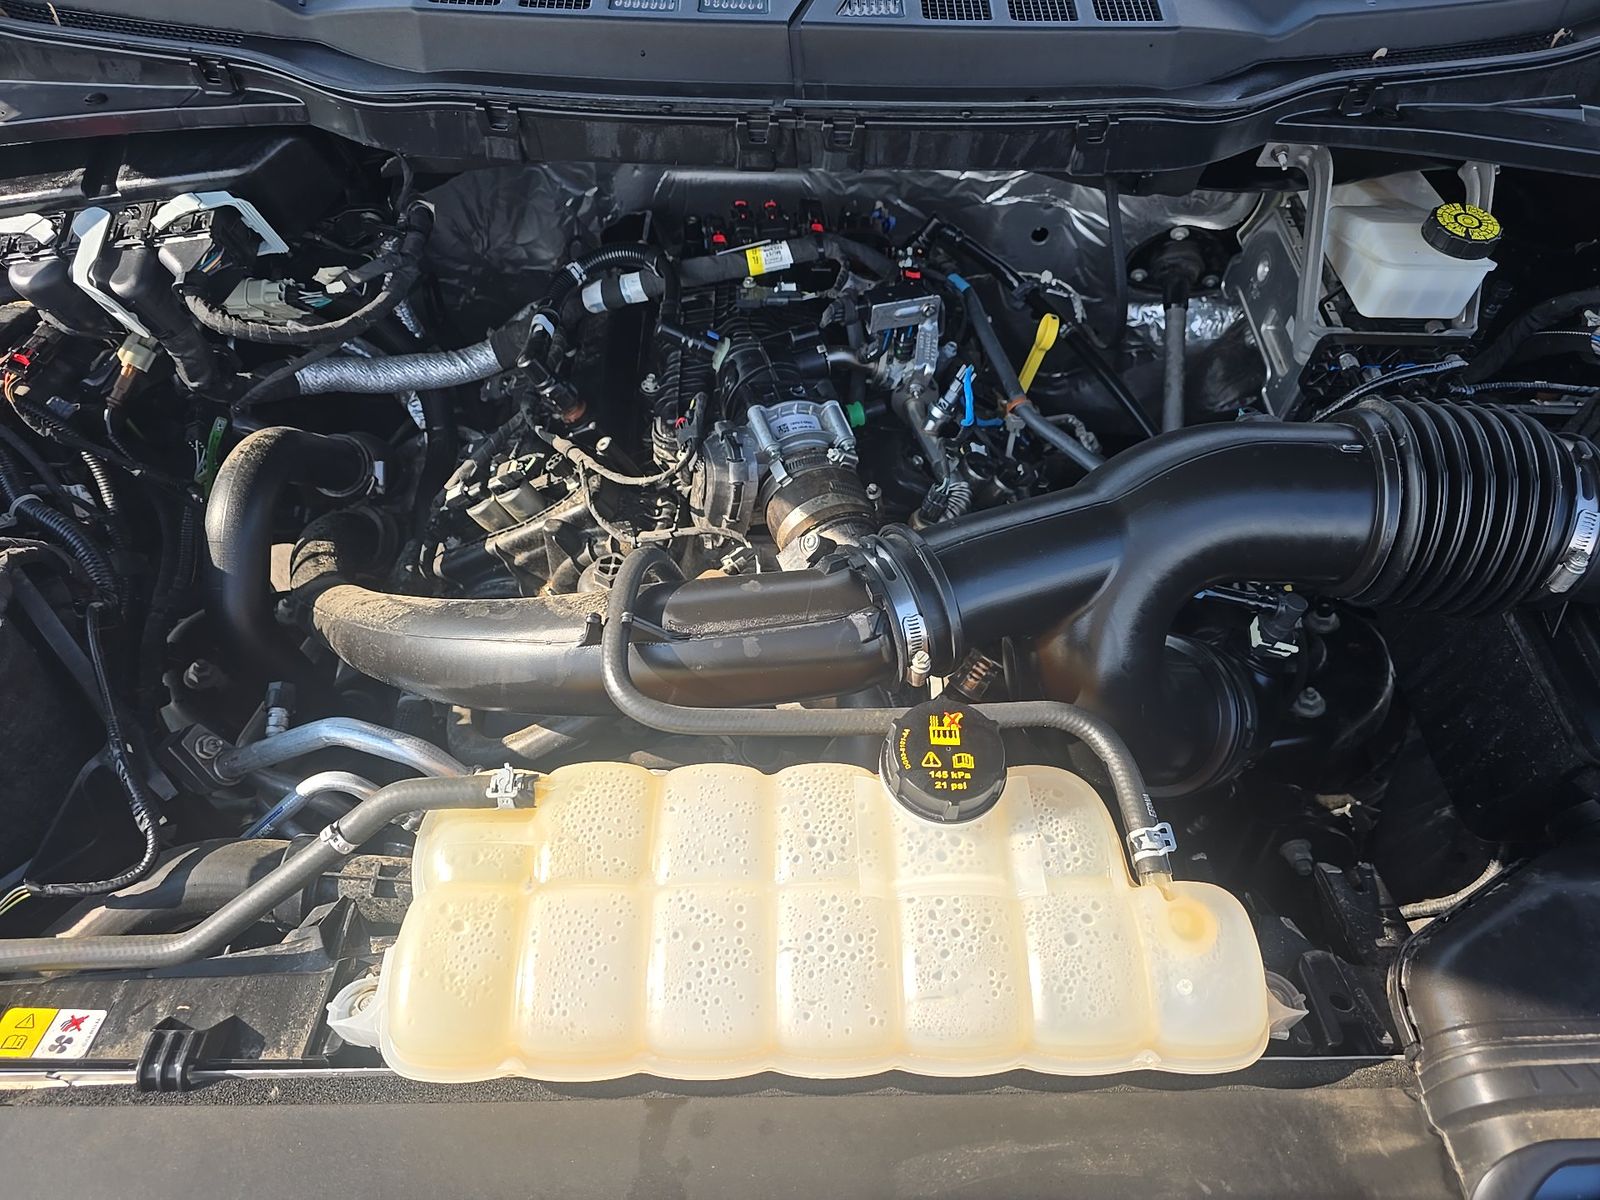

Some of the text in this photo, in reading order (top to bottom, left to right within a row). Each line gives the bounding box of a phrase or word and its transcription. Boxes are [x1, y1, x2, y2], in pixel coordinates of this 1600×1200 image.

[929, 770, 972, 779] 145 kPa
[934, 781, 968, 791] 21 psi
